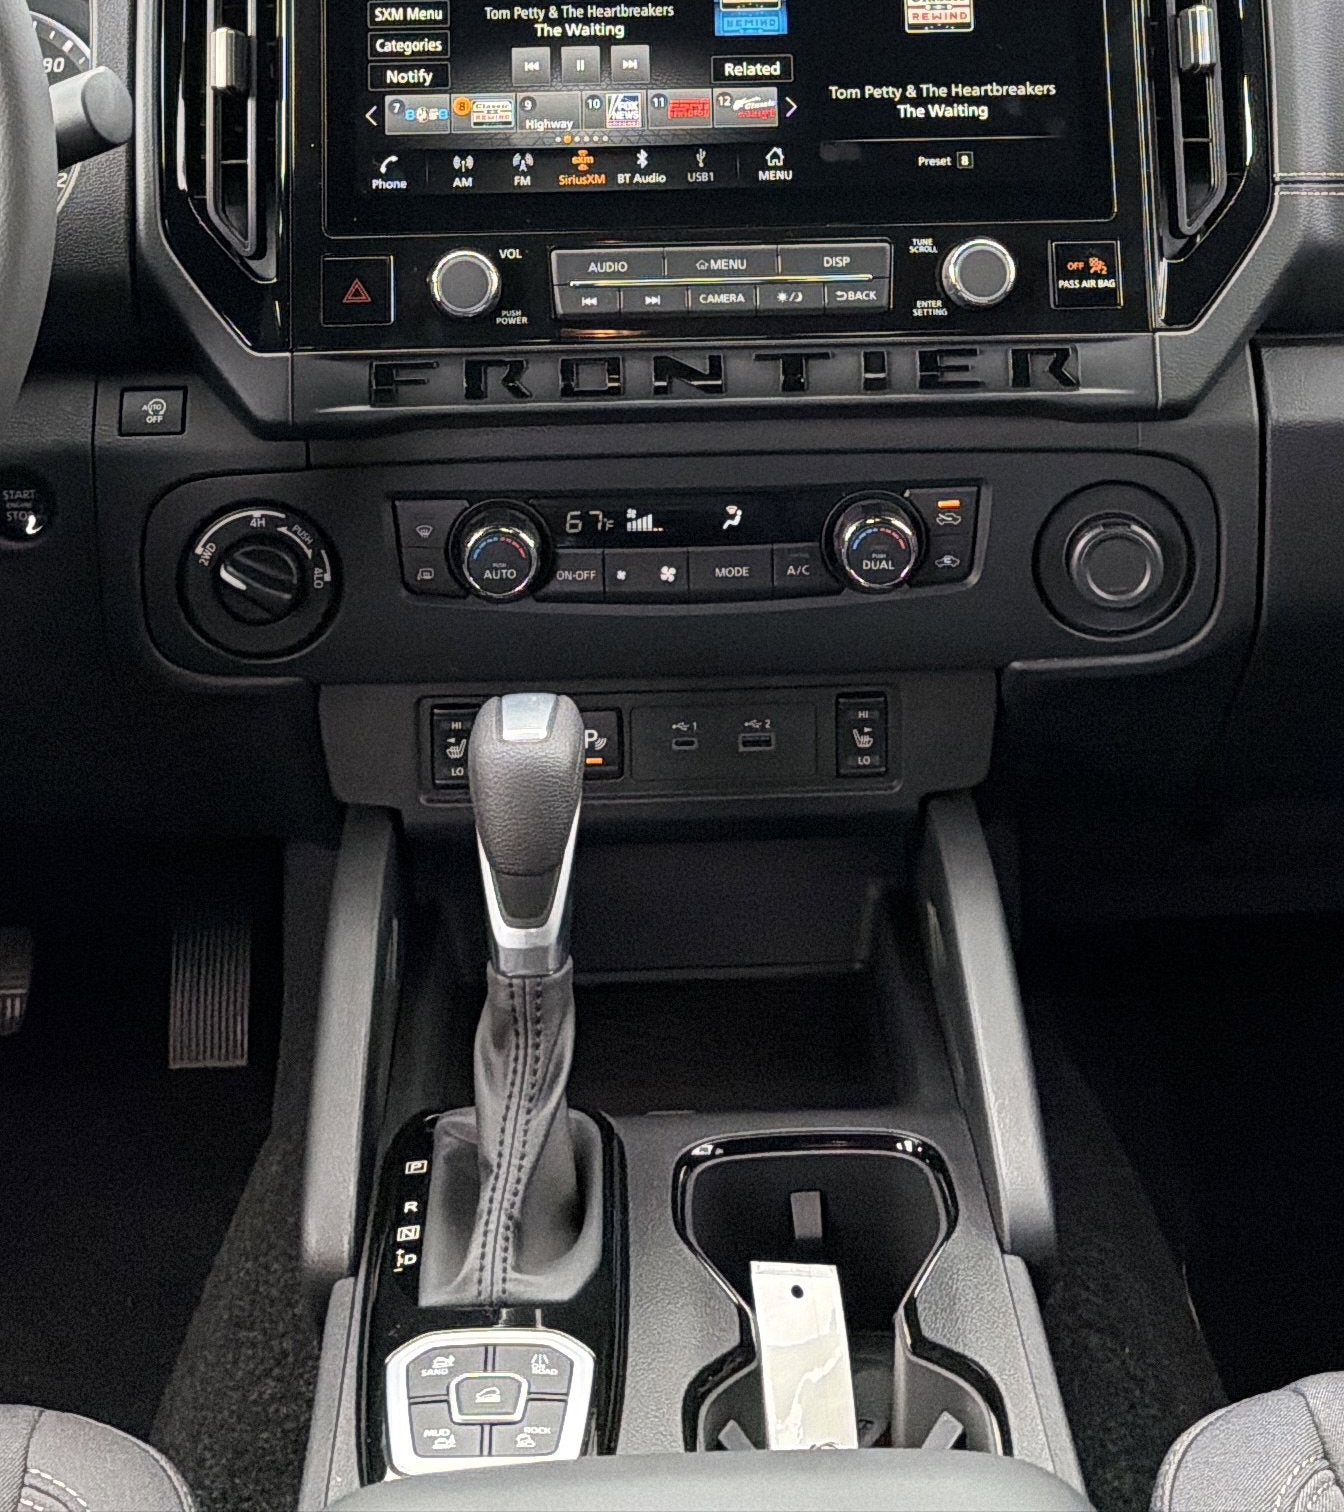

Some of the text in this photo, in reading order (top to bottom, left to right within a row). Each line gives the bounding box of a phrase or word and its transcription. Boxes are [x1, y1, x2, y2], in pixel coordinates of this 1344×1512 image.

[375, 7, 443, 21] SXM Menu
[485, 2, 675, 21] Tom Petty & The Heartbreakers
[912, 11, 968, 21] REWIND
[535, 22, 625, 39] The Waiting
[375, 39, 443, 55] Categories
[724, 61, 781, 76] Related
[386, 69, 433, 86] Notify
[829, 81, 1056, 101] Tom Petty & The Heartbreakers
[524, 99, 533, 111] 9
[586, 98, 602, 110] 10
[618, 101, 640, 111] FOX
[652, 96, 665, 108] 11
[717, 95, 732, 107] 12
[392, 102, 401, 114] 7
[897, 103, 989, 119] The Waiting
[612, 110, 640, 120] NEWS
[525, 118, 574, 131] Highway
[918, 156, 952, 168] Preset
[514, 176, 531, 186] FM
[558, 173, 607, 186] SiriusXM
[617, 172, 667, 184] BT Audio
[687, 171, 715, 182] USB1
[758, 170, 793, 181] MENU
[372, 178, 408, 190] Phone
[452, 177, 473, 188] AM
[912, 238, 933, 246] TUNE
[499, 248, 522, 260] VOL
[909, 245, 938, 254] SCROLL
[587, 261, 628, 273] AUDIO
[710, 258, 747, 271] MENU
[823, 256, 851, 268] DISP
[1067, 261, 1085, 271] OFF
[1058, 278, 1116, 288] PASS AIR BAG
[699, 293, 745, 305] CAMERA
[848, 290, 877, 302] BACK
[916, 300, 942, 308] ENTER
[501, 309, 522, 318] PUSH
[912, 308, 948, 317] SETTING
[496, 316, 529, 325] POWER
[371, 345, 1080, 404] FRONTIER
[146, 415, 164, 424] OFF
[2, 489, 36, 500] START
[249, 517, 266, 528] 4H
[291, 524, 314, 545] PUSH
[198, 542, 217, 567] 2WD
[786, 565, 810, 576] A/C
[862, 559, 895, 571] DUAL
[313, 567, 324, 589] 4LO
[483, 569, 517, 580] AUTO
[556, 570, 597, 580] ON-OFF
[715, 566, 750, 578] MODE
[858, 710, 869, 719] HI
[451, 721, 462, 730] HI
[764, 719, 771, 729] 2
[584, 729, 598, 749] P
[858, 756, 871, 765] LO
[451, 767, 464, 776] LO
[403, 1200, 419, 1214] R
[403, 1253, 418, 1265] D
[420, 1368, 449, 1377] SAND
[531, 1368, 559, 1376] ROAD
[423, 1428, 451, 1438] MUD
[523, 1426, 552, 1435] ROCK
